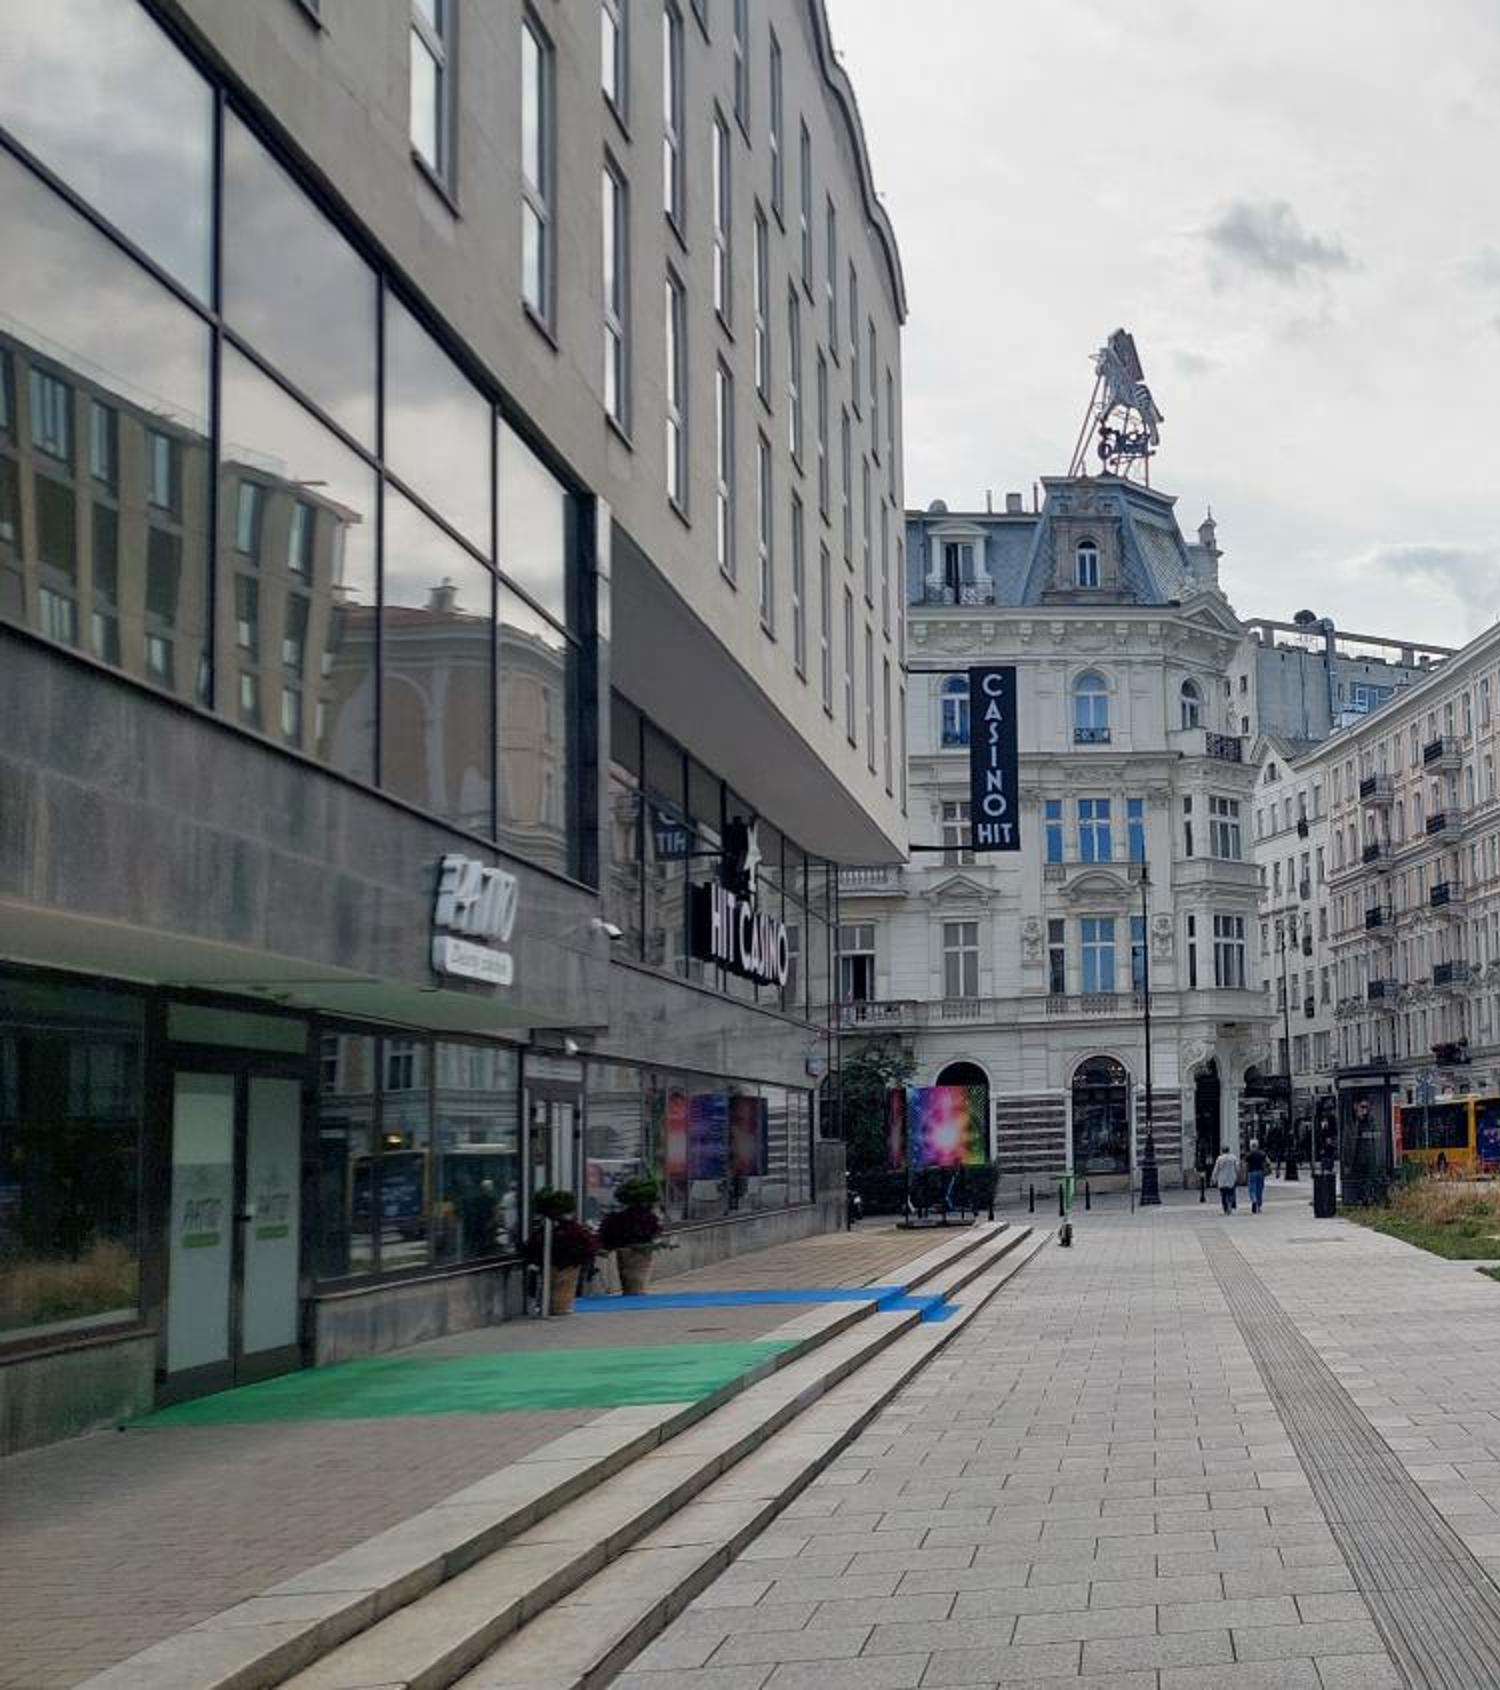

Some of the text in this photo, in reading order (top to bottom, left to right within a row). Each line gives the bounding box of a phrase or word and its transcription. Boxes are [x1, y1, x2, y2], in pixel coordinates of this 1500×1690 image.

[982, 673, 1007, 817] CASINO
[977, 823, 1012, 844] HIT
[711, 882, 788, 986] HIT CASINO
